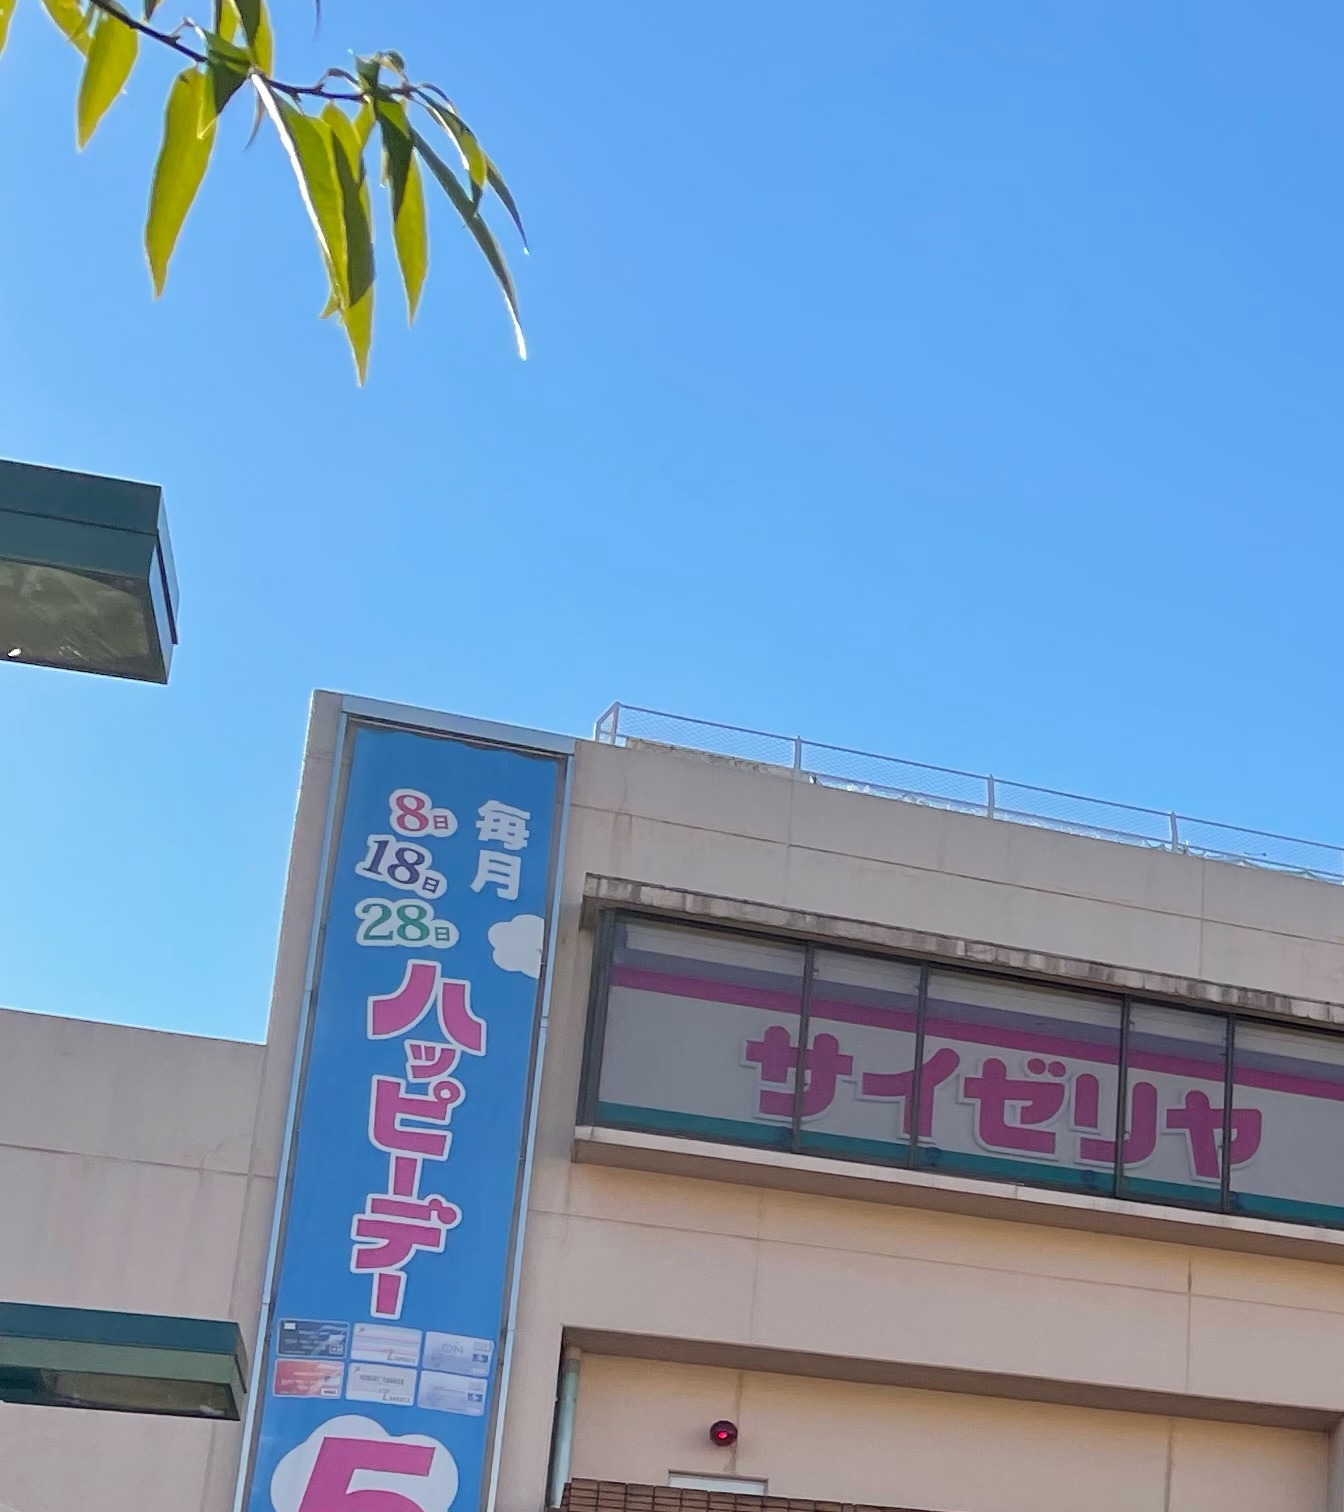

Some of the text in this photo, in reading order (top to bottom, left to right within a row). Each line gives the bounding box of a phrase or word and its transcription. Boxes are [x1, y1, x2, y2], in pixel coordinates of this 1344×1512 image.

[472, 799, 532, 901] 毎月
[351, 960, 487, 1319] ハッピーデー
[739, 1024, 1263, 1184] サイゼリヤ
